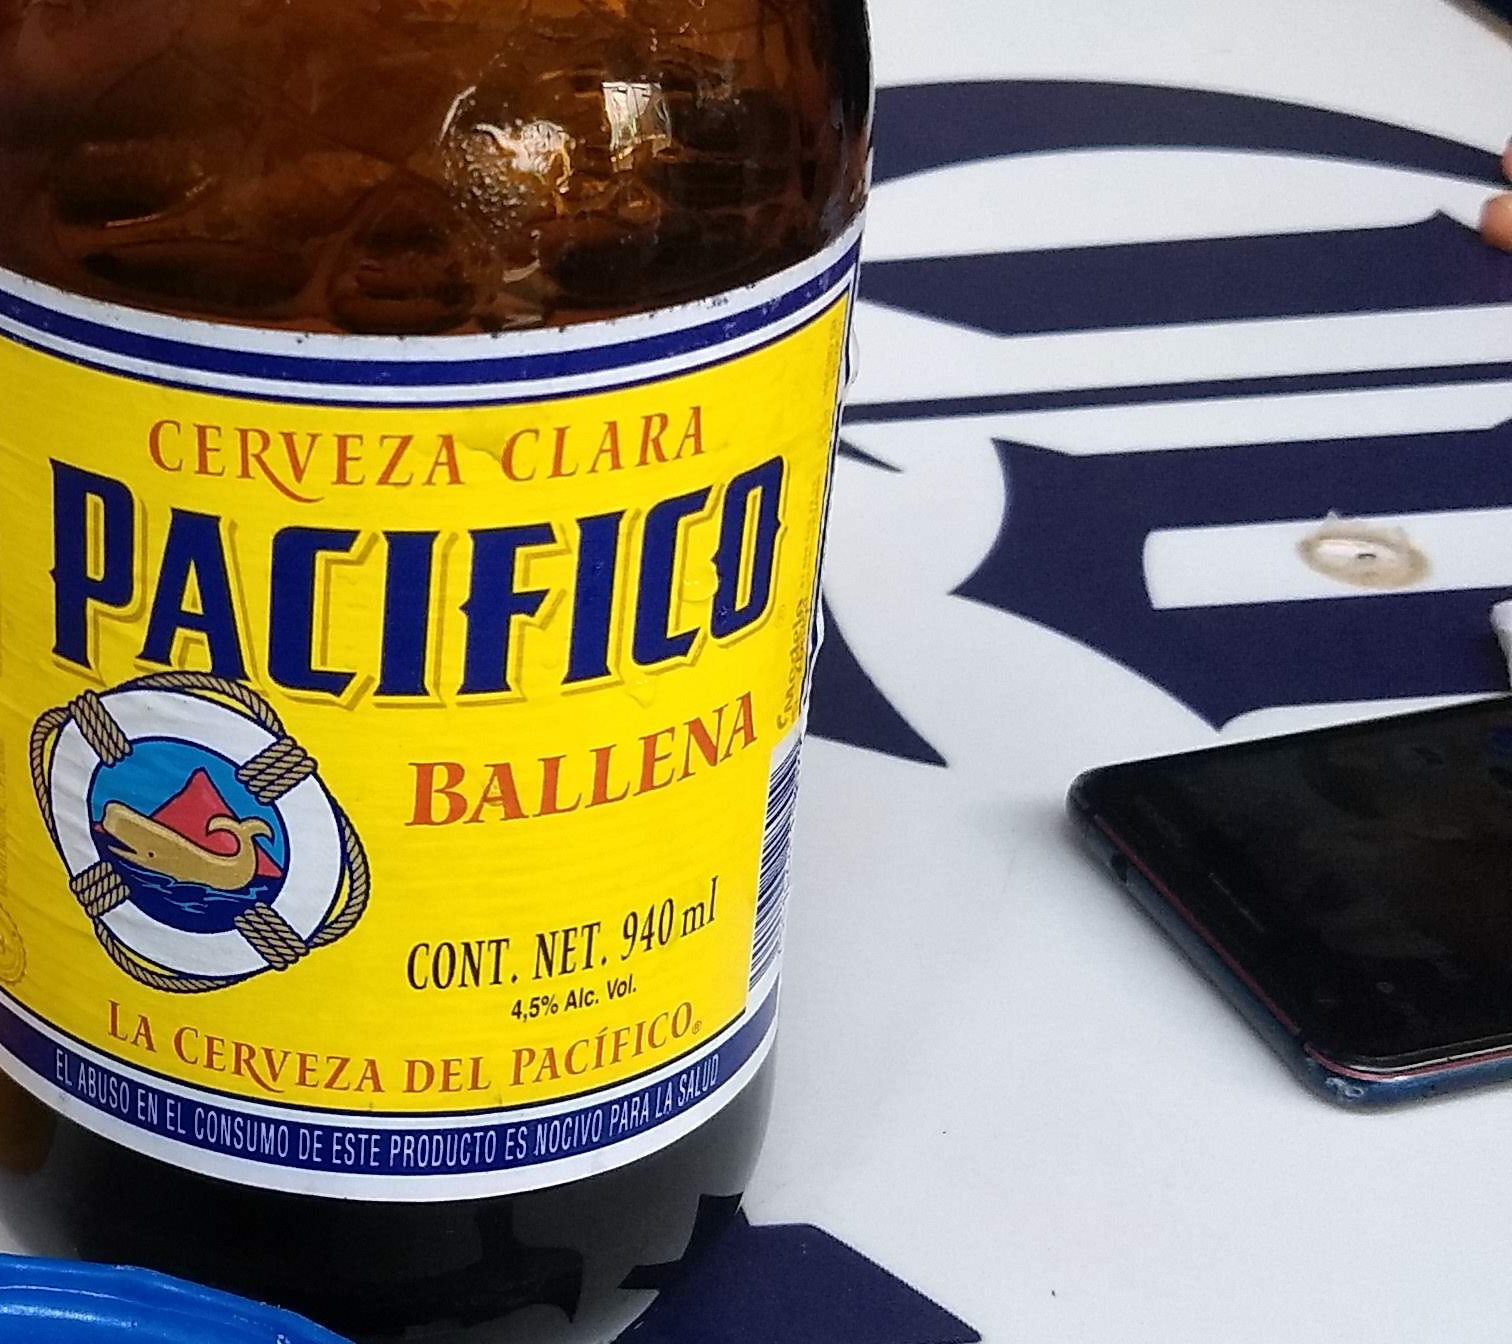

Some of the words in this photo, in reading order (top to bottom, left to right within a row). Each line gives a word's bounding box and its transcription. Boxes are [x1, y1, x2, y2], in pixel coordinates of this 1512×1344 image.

[148, 419, 465, 504] CERVEZA
[500, 405, 706, 482] CLARA
[49, 455, 788, 699] PACIFICO
[404, 691, 758, 827] BALLENA
[407, 938, 518, 990] CONT.
[532, 921, 608, 981] NET.
[621, 897, 675, 961] 940
[680, 875, 719, 938] ml
[108, 1000, 157, 1053] LA
[174, 1026, 385, 1093] CERVEZA
[402, 1056, 491, 1093] DEL
[511, 994, 559, 1023] 4,5%
[564, 986, 599, 1012] Alc.
[607, 974, 637, 1000] Vol.
[56, 1049, 73, 1086] EL
[77, 1062, 130, 1114] ABUSO
[137, 1088, 158, 1126] EN
[166, 1098, 186, 1135] EL
[194, 1107, 289, 1158] CONSUMO
[299, 1128, 323, 1162] DE
[332, 1132, 381, 1166] ESTE
[389, 1130, 497, 1167] PRODUCTO
[504, 1126, 528, 1160] ES
[534, 1109, 603, 1156] NOCIVO
[609, 1092, 649, 1137] PARA
[655, 1081, 673, 1118] LA
[678, 1053, 719, 1106] SALUD
